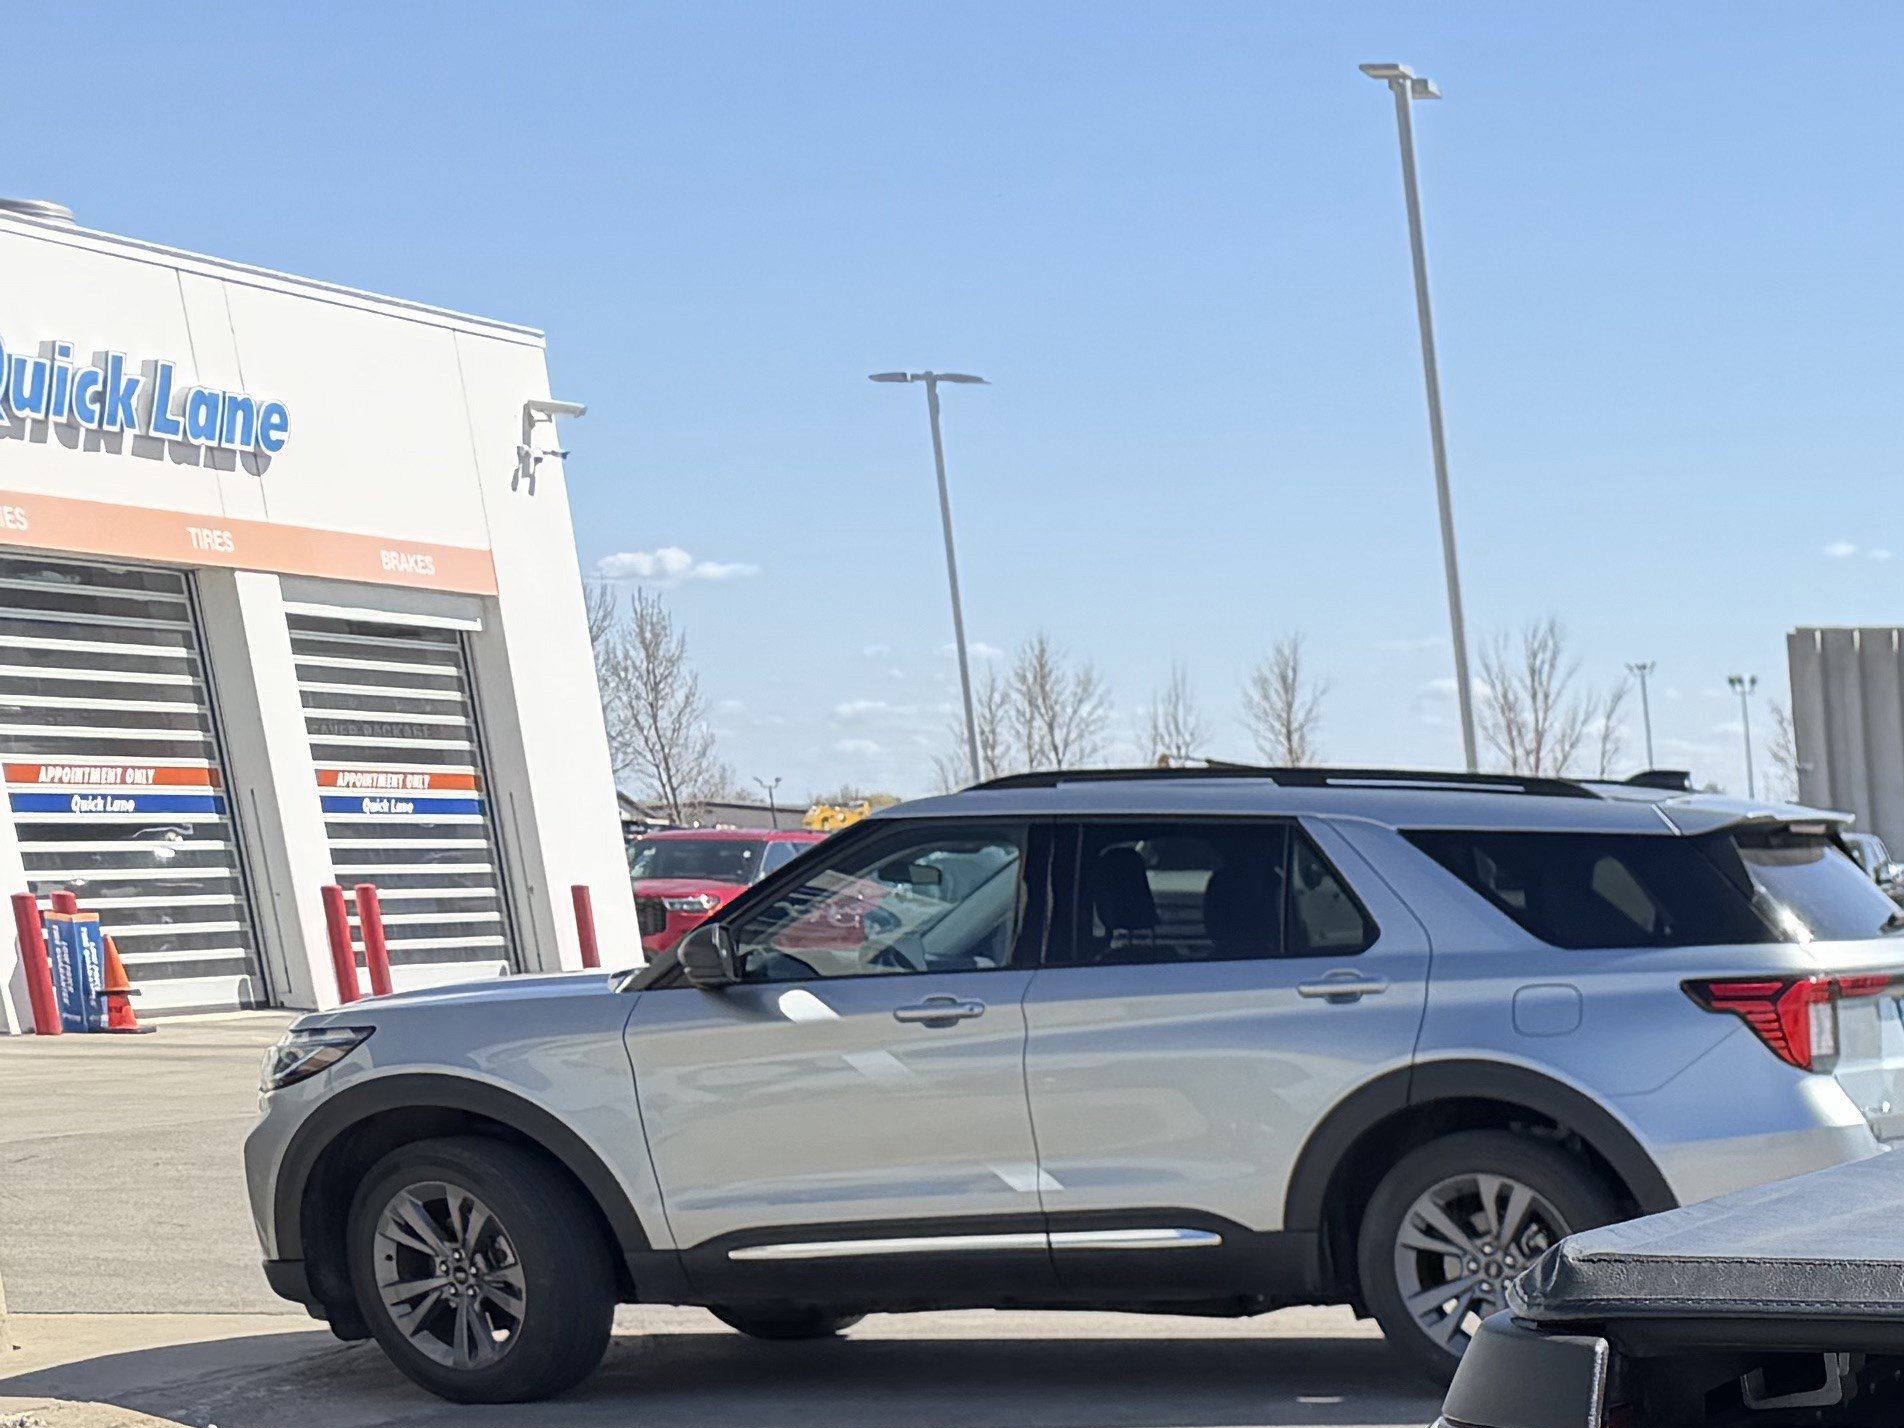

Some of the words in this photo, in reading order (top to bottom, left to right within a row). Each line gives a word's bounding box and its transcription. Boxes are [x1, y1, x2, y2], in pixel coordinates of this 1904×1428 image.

[0, 332, 146, 436] uick
[149, 358, 291, 455] Lane
[186, 526, 236, 552] TIRES
[380, 549, 436, 576] BRAKES
[38, 766, 123, 784] APPOINTMENT
[125, 768, 156, 785] ONLY
[336, 772, 404, 789] APPOINTMENT
[406, 774, 431, 790] ONLY
[71, 795, 104, 814] Quick
[106, 796, 136, 812] Lane
[362, 797, 389, 815] Quick
[391, 799, 415, 814] Lane
